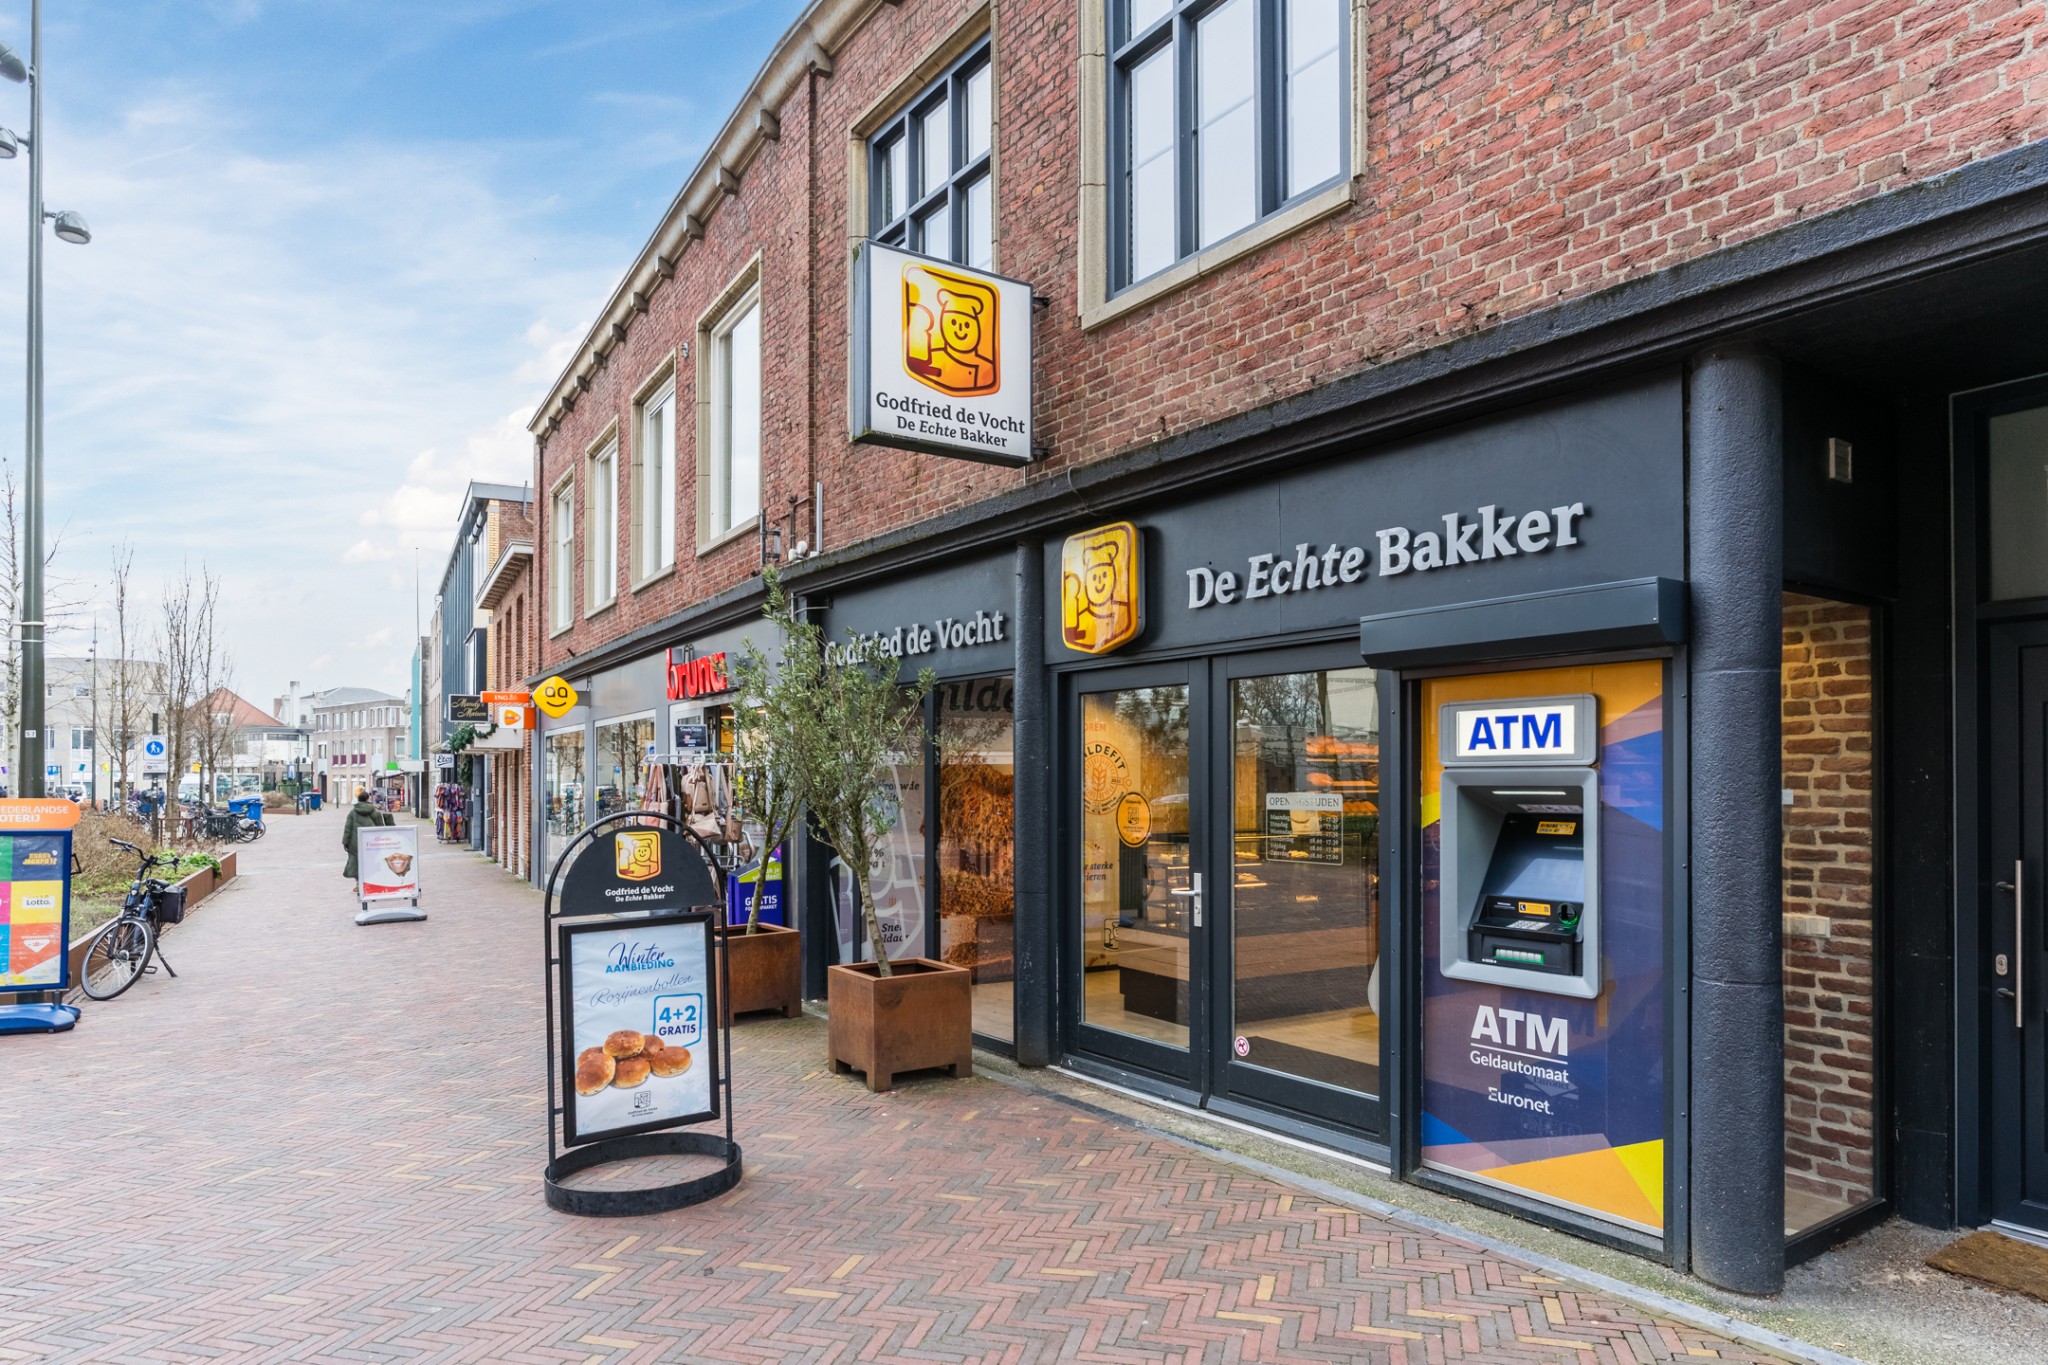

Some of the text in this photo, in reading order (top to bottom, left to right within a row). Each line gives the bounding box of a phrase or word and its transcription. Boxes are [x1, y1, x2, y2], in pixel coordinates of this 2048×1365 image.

[876, 392, 1025, 434] Godfried de Vocht
[896, 416, 1008, 447] De Echte Bakker
[1186, 502, 1584, 610] De Echte Bakker
[906, 623, 932, 655] de
[936, 610, 1003, 649] Vocht
[665, 647, 728, 700] bruna
[1468, 713, 1561, 750] ATM
[0, 806, 69, 814] EDERLANDSE
[0, 814, 40, 822] OTERIJ
[1090, 861, 1114, 870] sterke
[605, 884, 674, 896] Godfried de Vocht
[625, 894, 642, 902] Echte
[745, 895, 778, 907] GTIS
[605, 958, 675, 974] AANBIEDING
[608, 942, 665, 969] Winter
[590, 973, 694, 1008] Rozijnenbollen
[659, 1005, 697, 1023] 4+2
[658, 1024, 697, 1036] GRATIS
[1470, 1005, 1568, 1057] ATM
[1470, 1050, 1569, 1083] Geldautomaat
